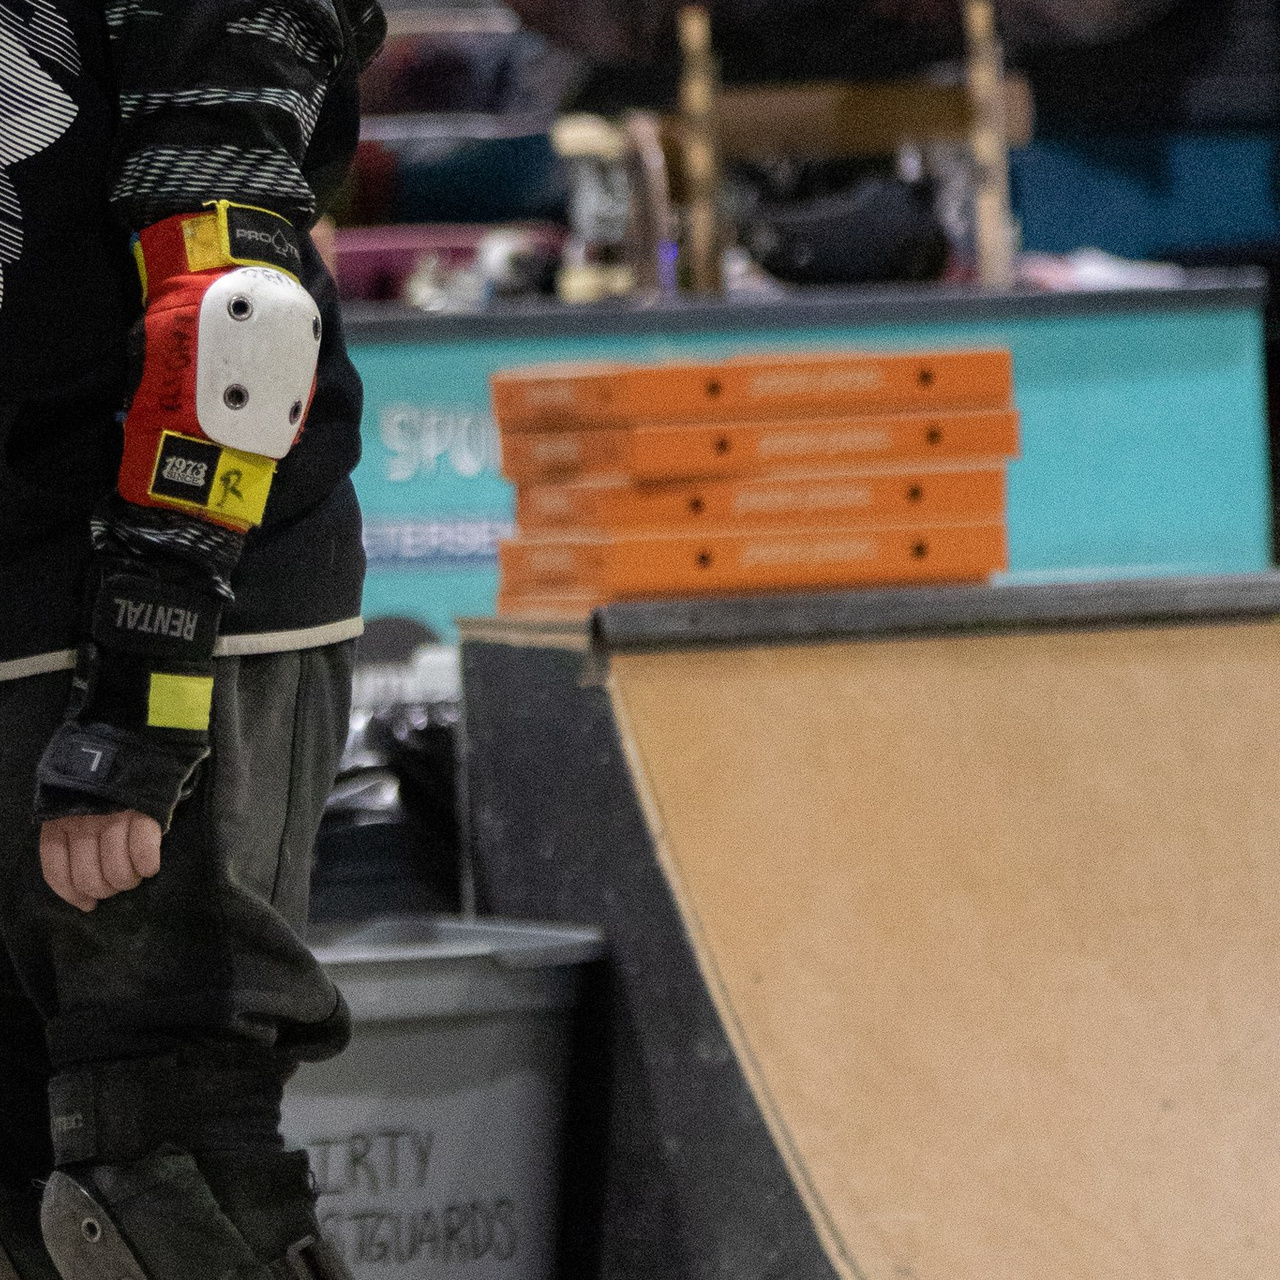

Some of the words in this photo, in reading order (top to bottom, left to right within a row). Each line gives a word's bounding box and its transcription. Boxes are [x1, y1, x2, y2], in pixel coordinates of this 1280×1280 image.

[166, 456, 208, 479] 1973
[216, 468, 244, 507] R
[114, 596, 198, 642] RENTAL
[80, 747, 103, 773] L
[310, 1127, 434, 1195] IRTY
